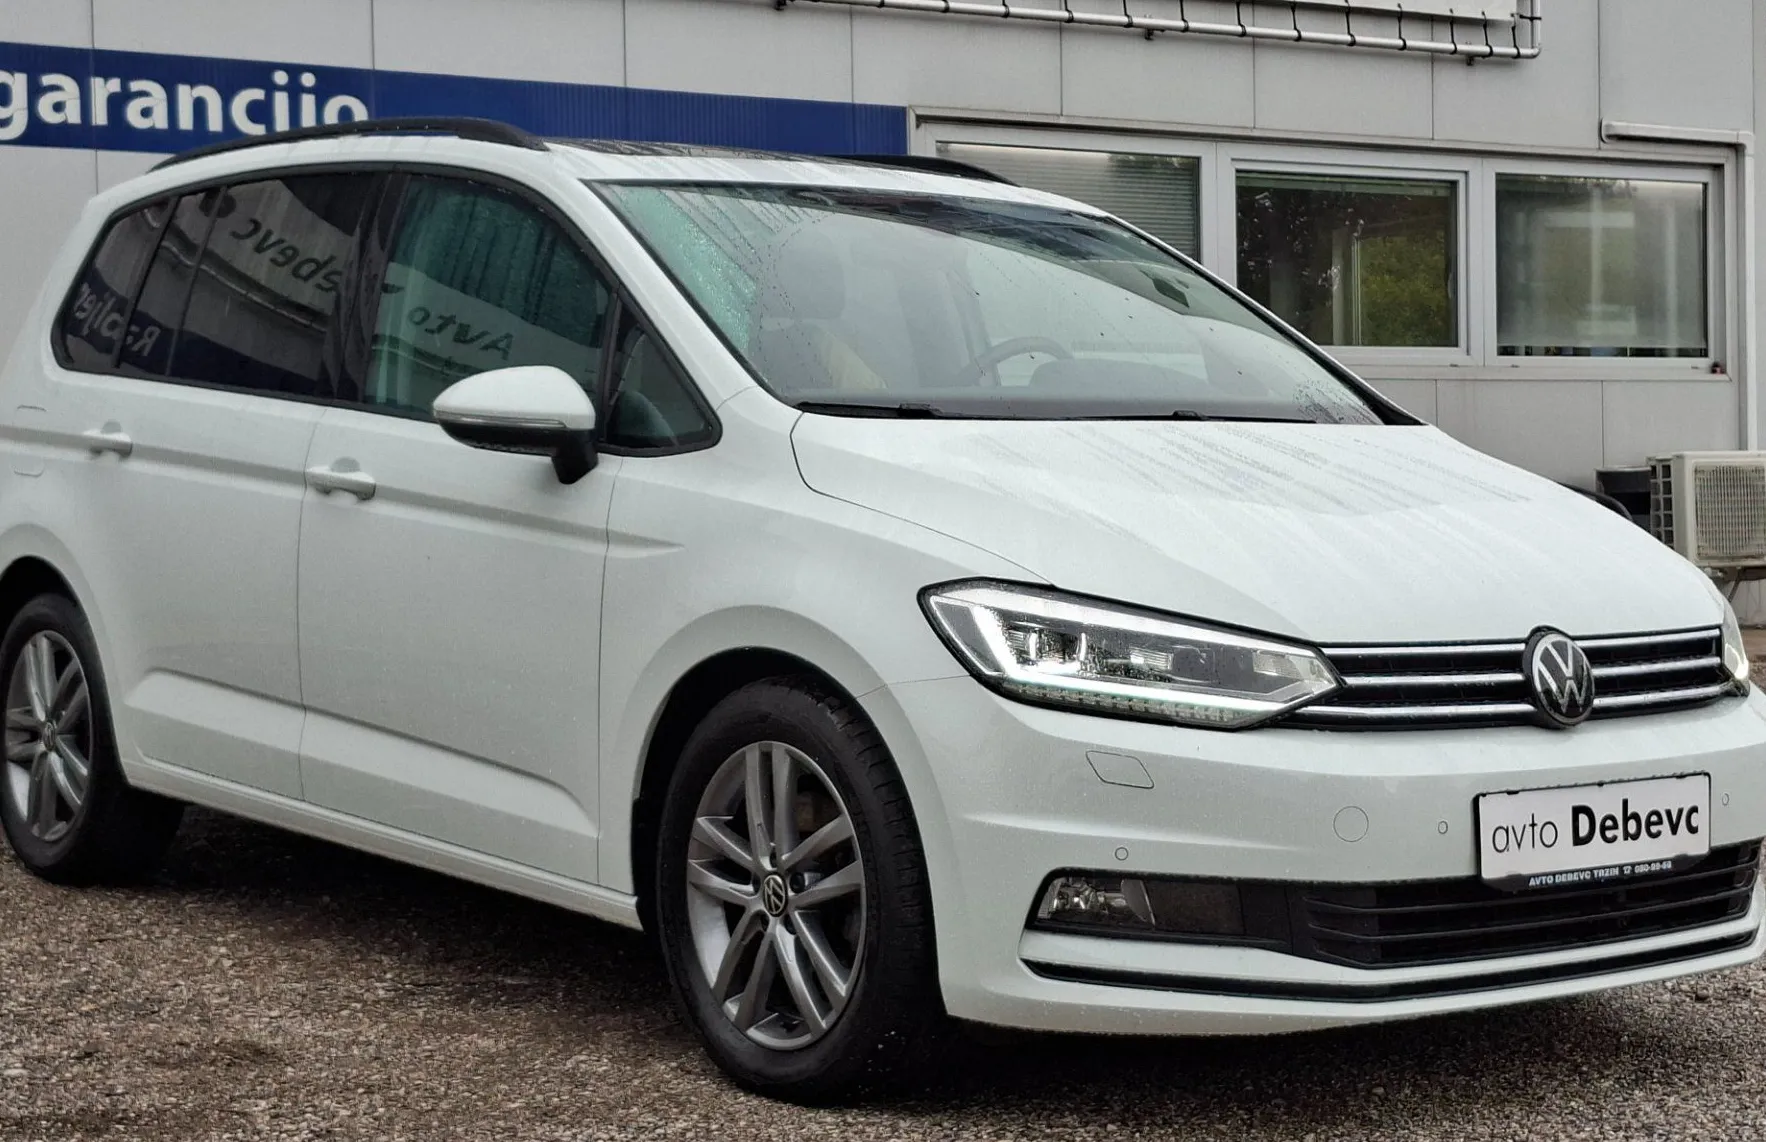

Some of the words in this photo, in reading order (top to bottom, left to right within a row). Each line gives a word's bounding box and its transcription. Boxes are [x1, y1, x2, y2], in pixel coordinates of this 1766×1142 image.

[1492, 812, 1559, 854] avto
[1571, 797, 1699, 848] Debevc
[1528, 874, 1554, 887] AVTO
[1555, 870, 1591, 883] DEBEVC
